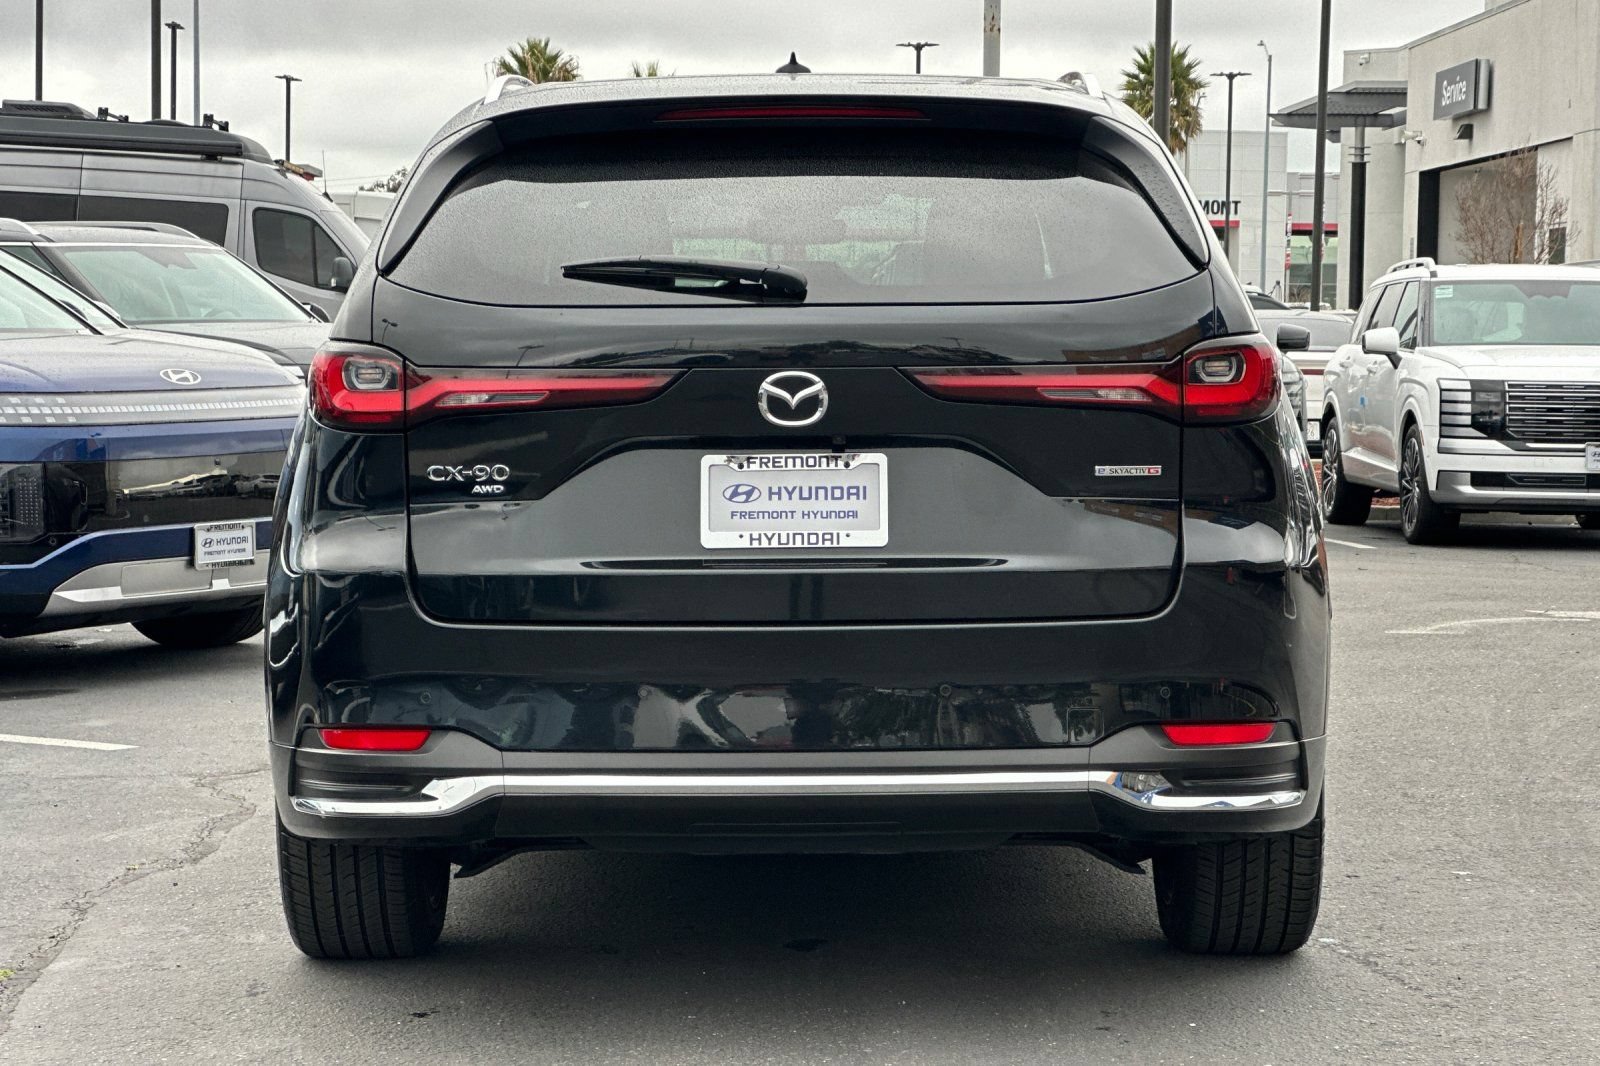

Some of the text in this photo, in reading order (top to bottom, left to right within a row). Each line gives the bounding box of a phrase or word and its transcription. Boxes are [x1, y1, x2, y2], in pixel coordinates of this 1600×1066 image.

[1442, 75, 1466, 106] Service
[746, 455, 842, 469] FREMONT
[426, 464, 510, 481] CX-90
[471, 485, 504, 494] AWD
[768, 486, 867, 501] HYUNDAI
[730, 510, 858, 520] FREMONT HYUNDAI
[209, 523, 242, 531] FREMONT
[216, 536, 249, 546] HYUNDAI
[749, 532, 841, 546] HYUNDAI
